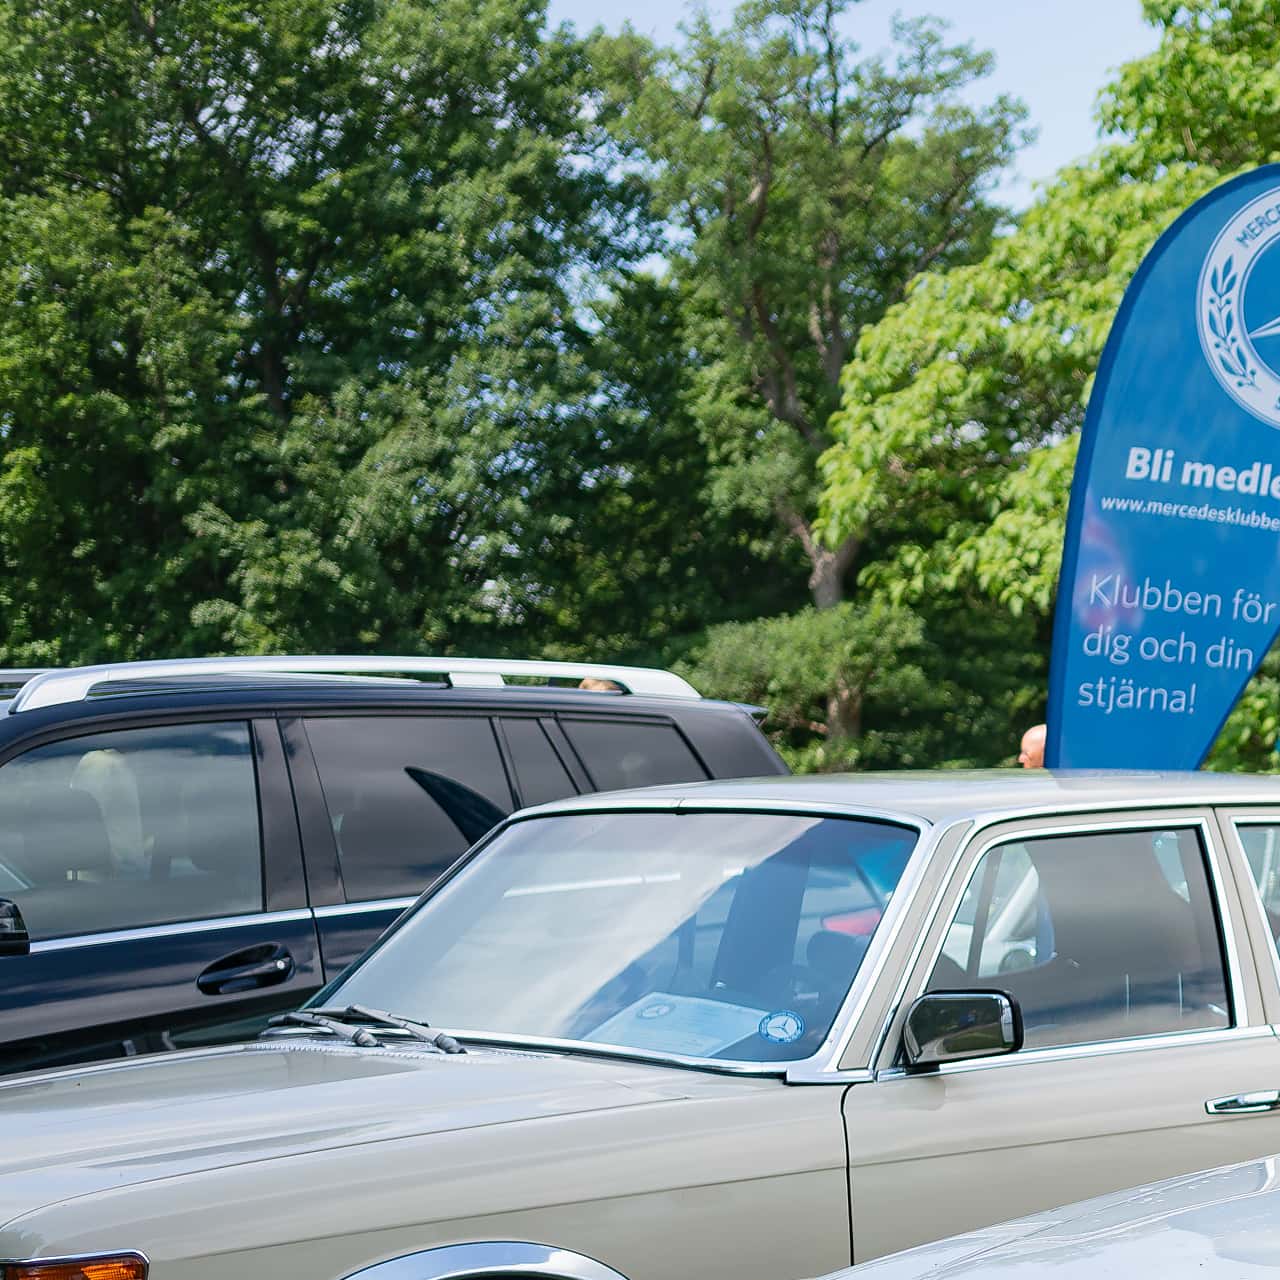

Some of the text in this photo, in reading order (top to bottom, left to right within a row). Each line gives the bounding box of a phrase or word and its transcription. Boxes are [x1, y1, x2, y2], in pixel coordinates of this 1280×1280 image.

[1125, 447, 1175, 482] Bli
[1089, 573, 1277, 624] Klubben för
[1082, 624, 1254, 671] dig och din
[1078, 676, 1197, 714] stjärna!
